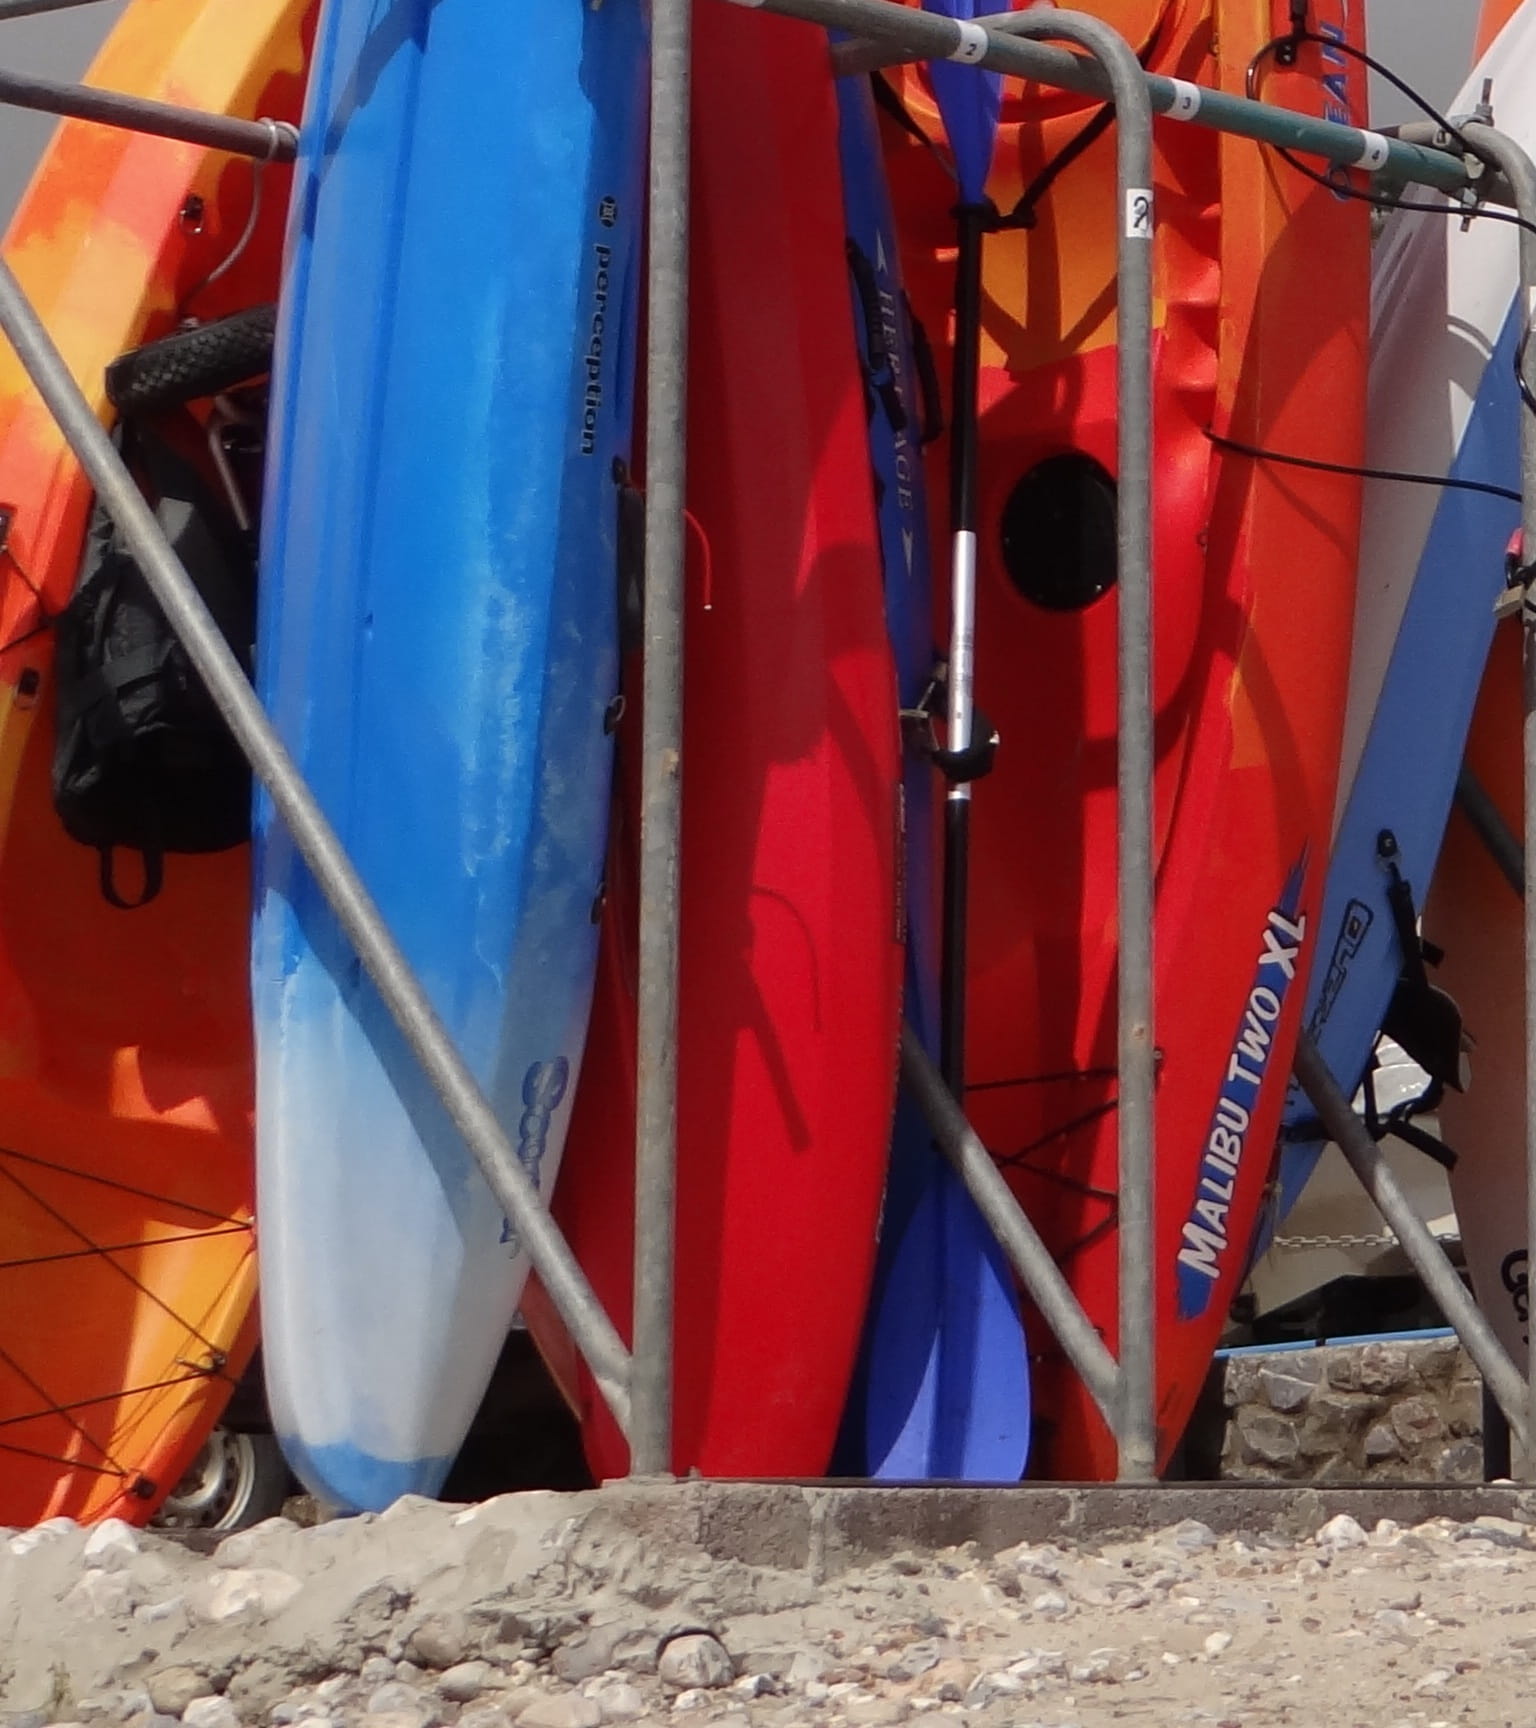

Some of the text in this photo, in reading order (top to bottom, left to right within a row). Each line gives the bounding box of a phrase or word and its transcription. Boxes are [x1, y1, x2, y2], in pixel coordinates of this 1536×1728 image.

[965, 42, 978, 57] 2
[1181, 95, 1192, 111] 3
[1319, 19, 1353, 203] OEAN
[581, 242, 612, 456] perception
[1176, 910, 1307, 1280] MALIBU TWO XL
